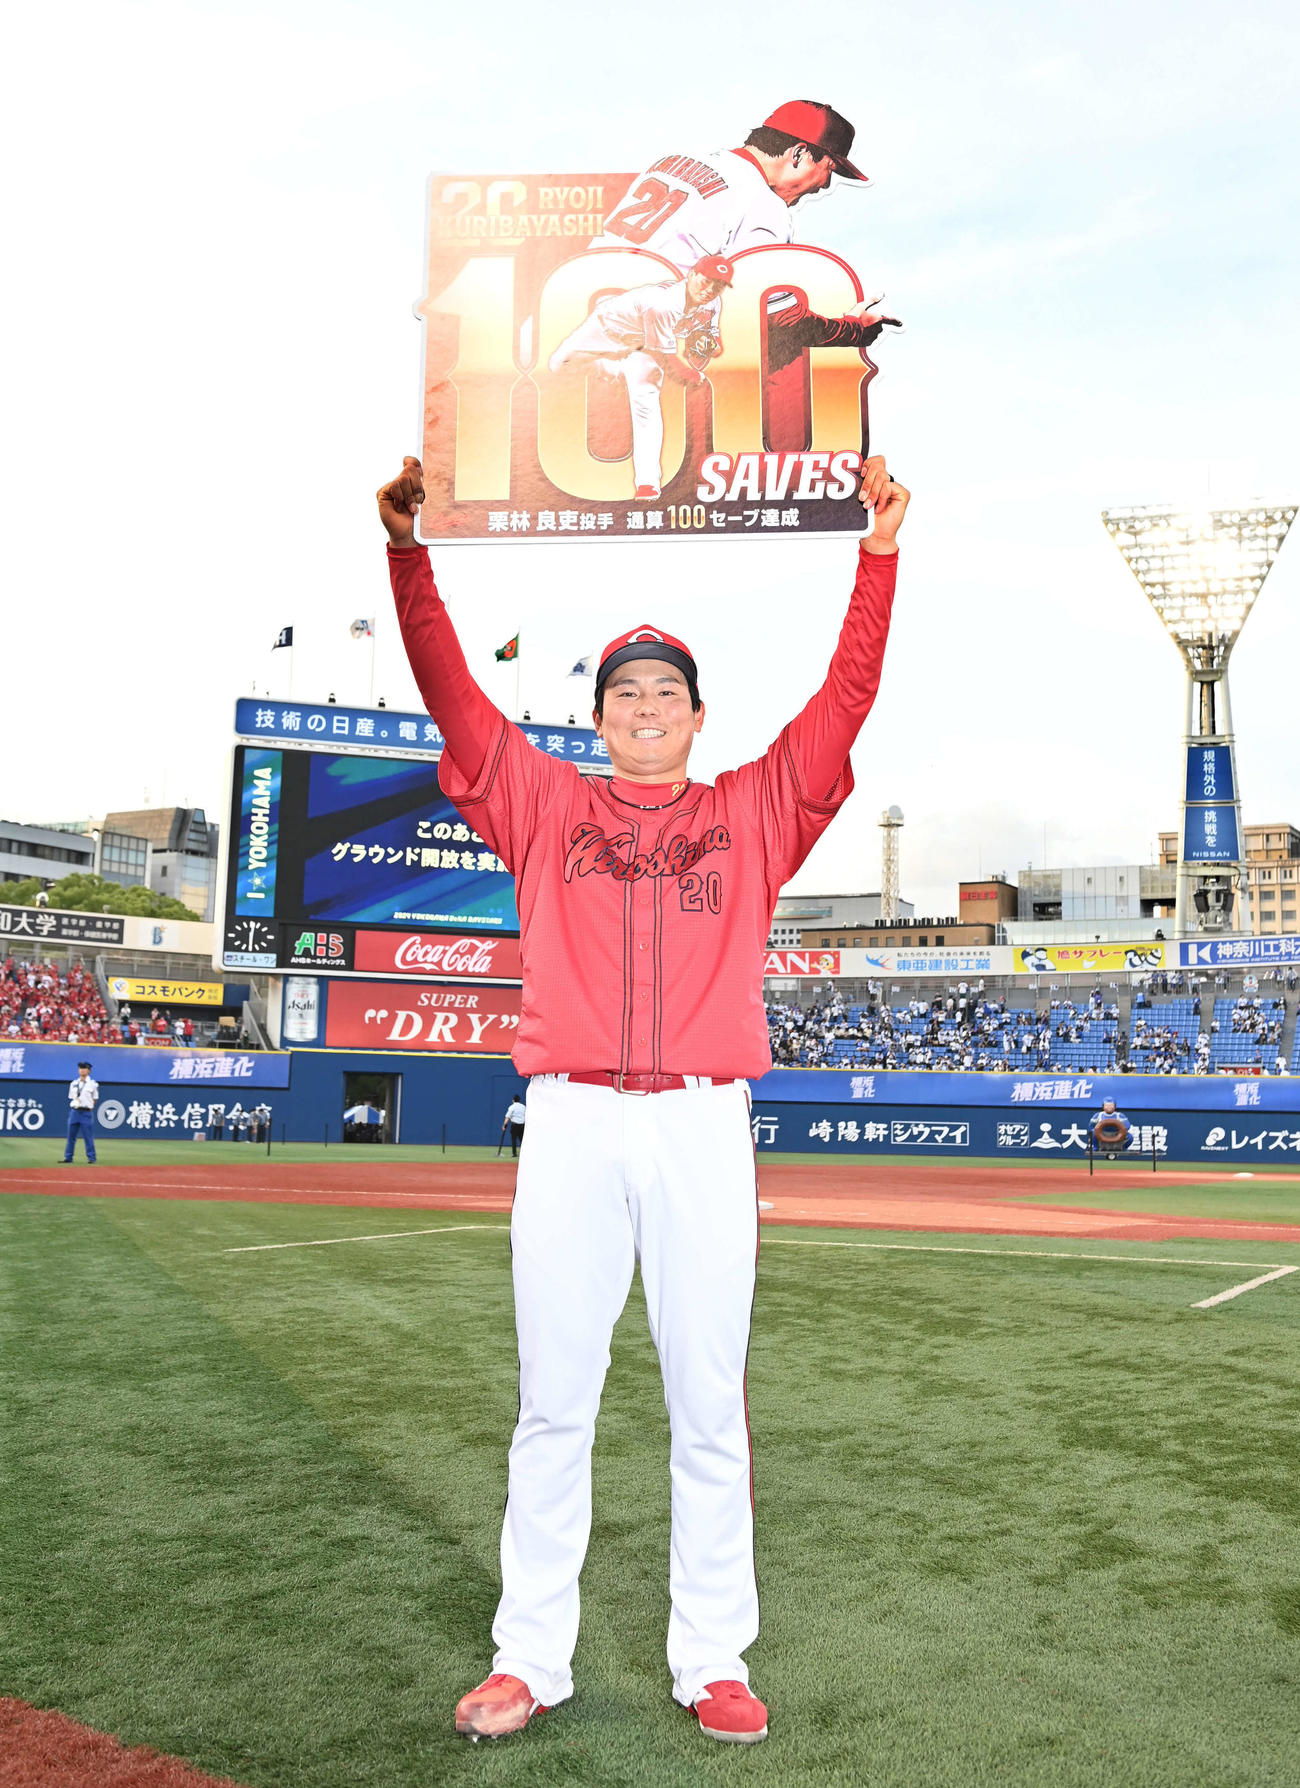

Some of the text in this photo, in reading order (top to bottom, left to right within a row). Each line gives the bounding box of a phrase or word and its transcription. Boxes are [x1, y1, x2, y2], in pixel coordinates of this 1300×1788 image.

[538, 186, 605, 211] RYOJI
[697, 450, 863, 503] SAVES
[488, 510, 531, 533] 栗林
[1203, 750, 1216, 797] 規格外の
[248, 767, 273, 871] YOKOHAMA
[1204, 810, 1218, 847] 挑戦を
[678, 872, 722, 915] 20
[763, 952, 810, 974] AN
[897, 958, 991, 972] 東亜建設工業
[418, 992, 479, 1009] SUPER
[168, 1057, 255, 1080] 横浜進化
[1010, 1079, 1093, 1102] 横浜進化
[809, 1119, 889, 1143] 崎陽軒
